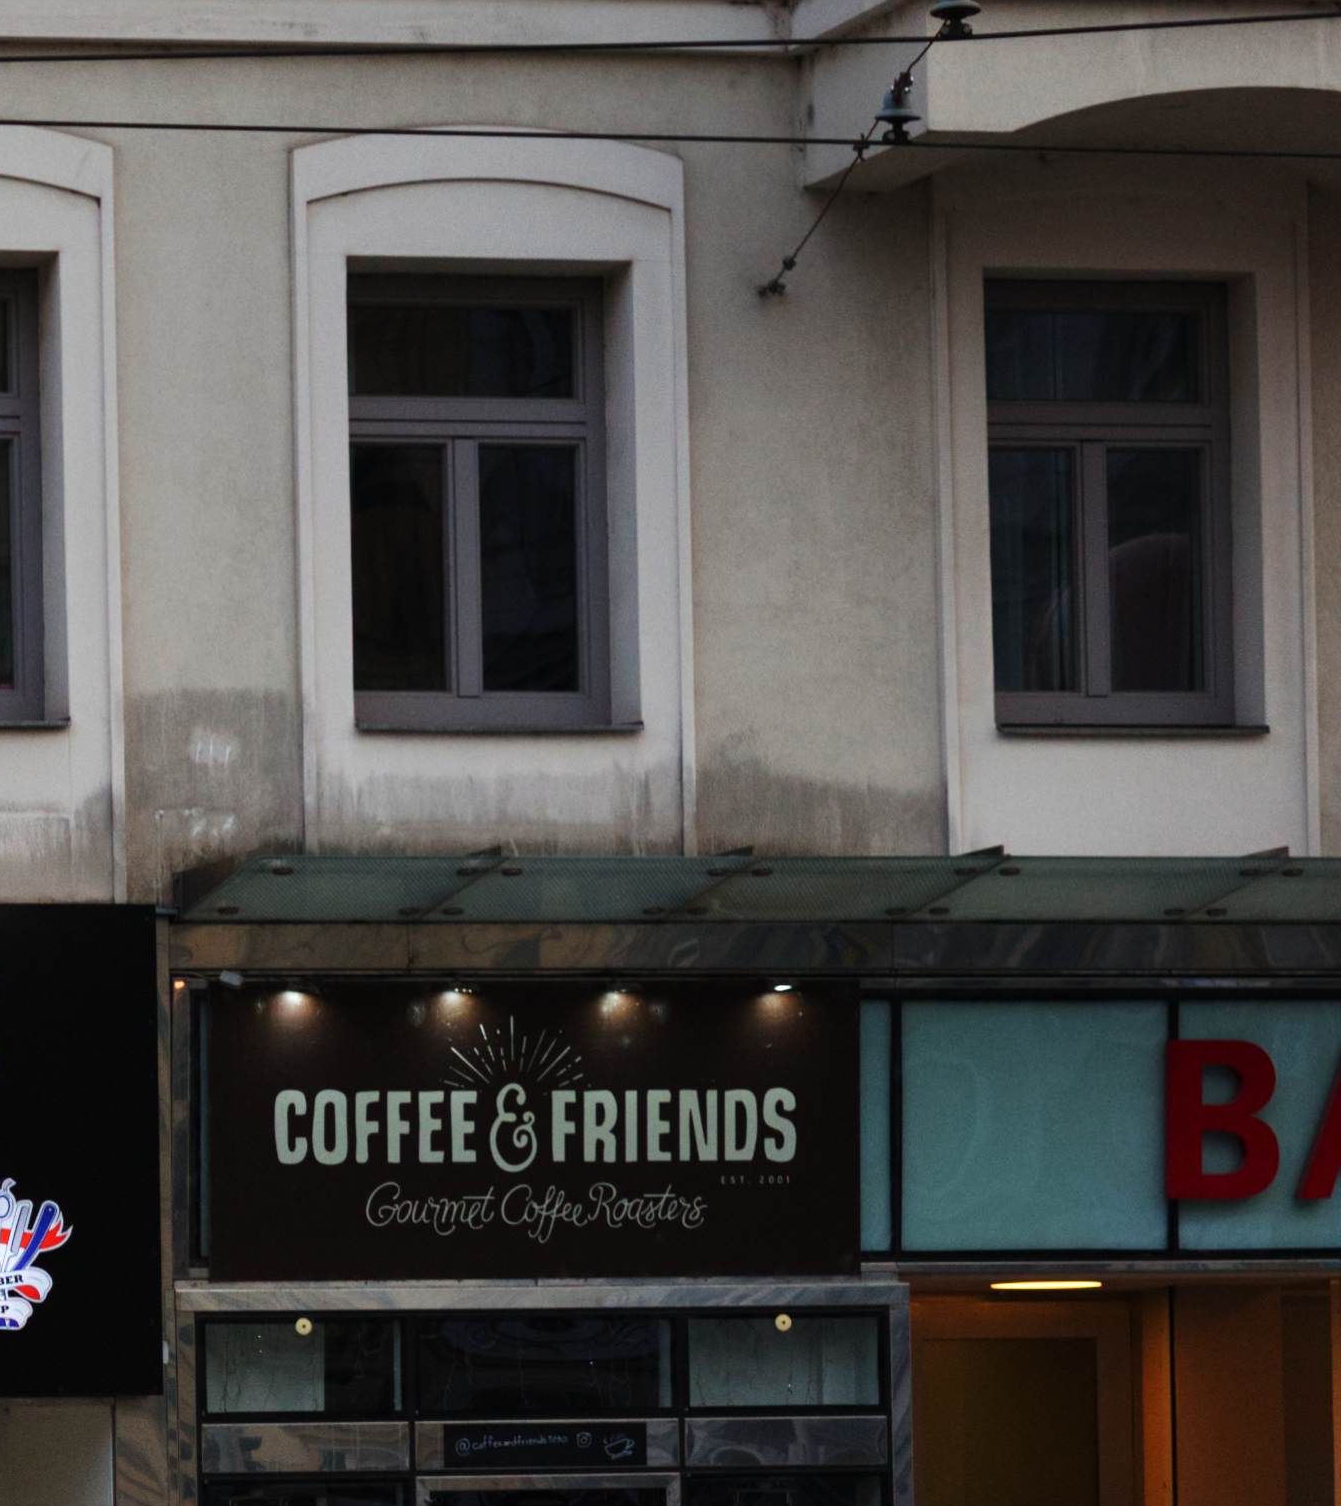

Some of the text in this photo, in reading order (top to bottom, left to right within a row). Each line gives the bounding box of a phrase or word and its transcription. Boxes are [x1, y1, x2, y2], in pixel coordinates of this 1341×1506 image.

[273, 1082, 798, 1174] COFFEE & FRIENDS
[365, 1180, 708, 1244] Gourmet Coffee Roasters
[720, 1175, 792, 1185] EST. 2001
